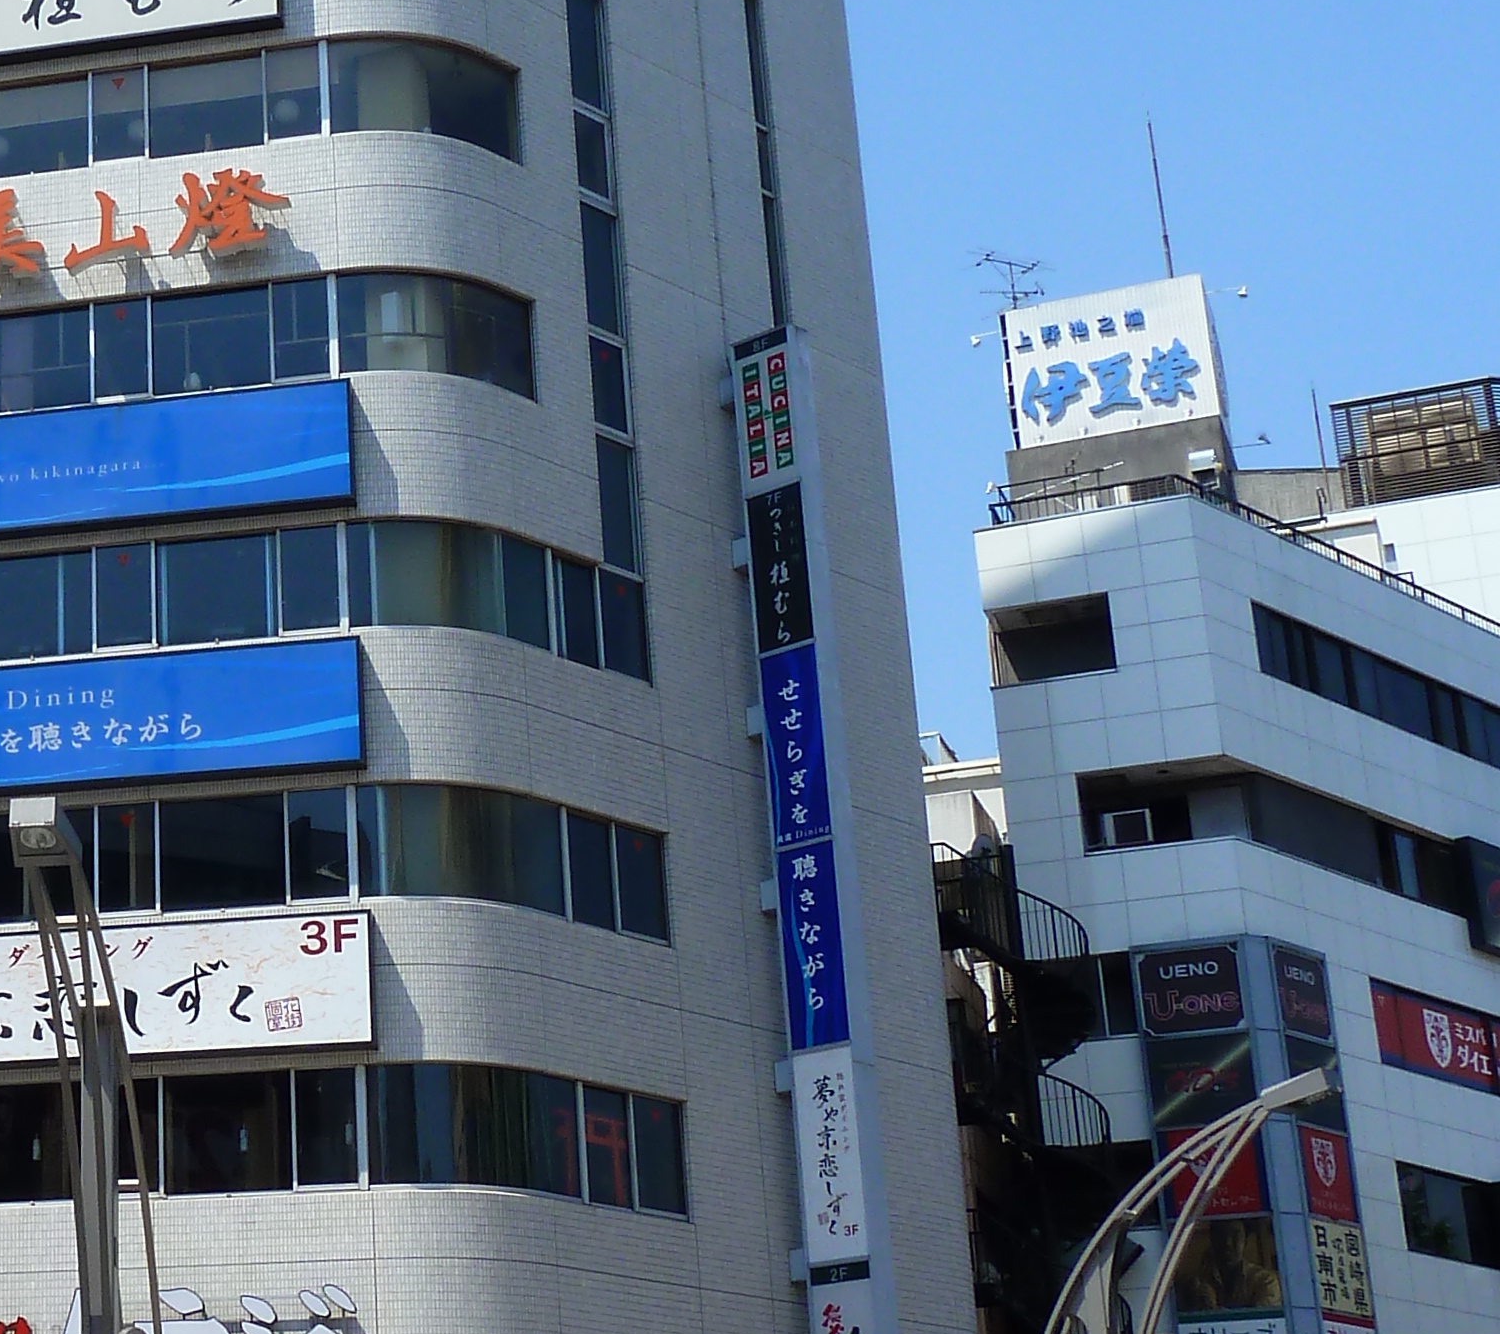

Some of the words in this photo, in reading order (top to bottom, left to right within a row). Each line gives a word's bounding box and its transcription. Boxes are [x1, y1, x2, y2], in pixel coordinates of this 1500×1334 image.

[744, 366, 768, 476] ITALIA
[768, 354, 794, 468] CUCINA
[769, 562, 793, 646] 植むら
[7, 684, 117, 712] Dining
[776, 678, 809, 825] せせらぎを
[298, 917, 362, 957] 3F
[789, 855, 827, 1011] 聴きながら
[1159, 960, 1219, 981] UENO
[1283, 965, 1316, 986] UENO
[1456, 1044, 1499, 1076] ダイエ
[843, 1223, 860, 1238] 3F
[829, 1266, 849, 1282] 2F
[1314, 1224, 1338, 1307] 日南市
[1344, 1229, 1369, 1314] 宮崎県
